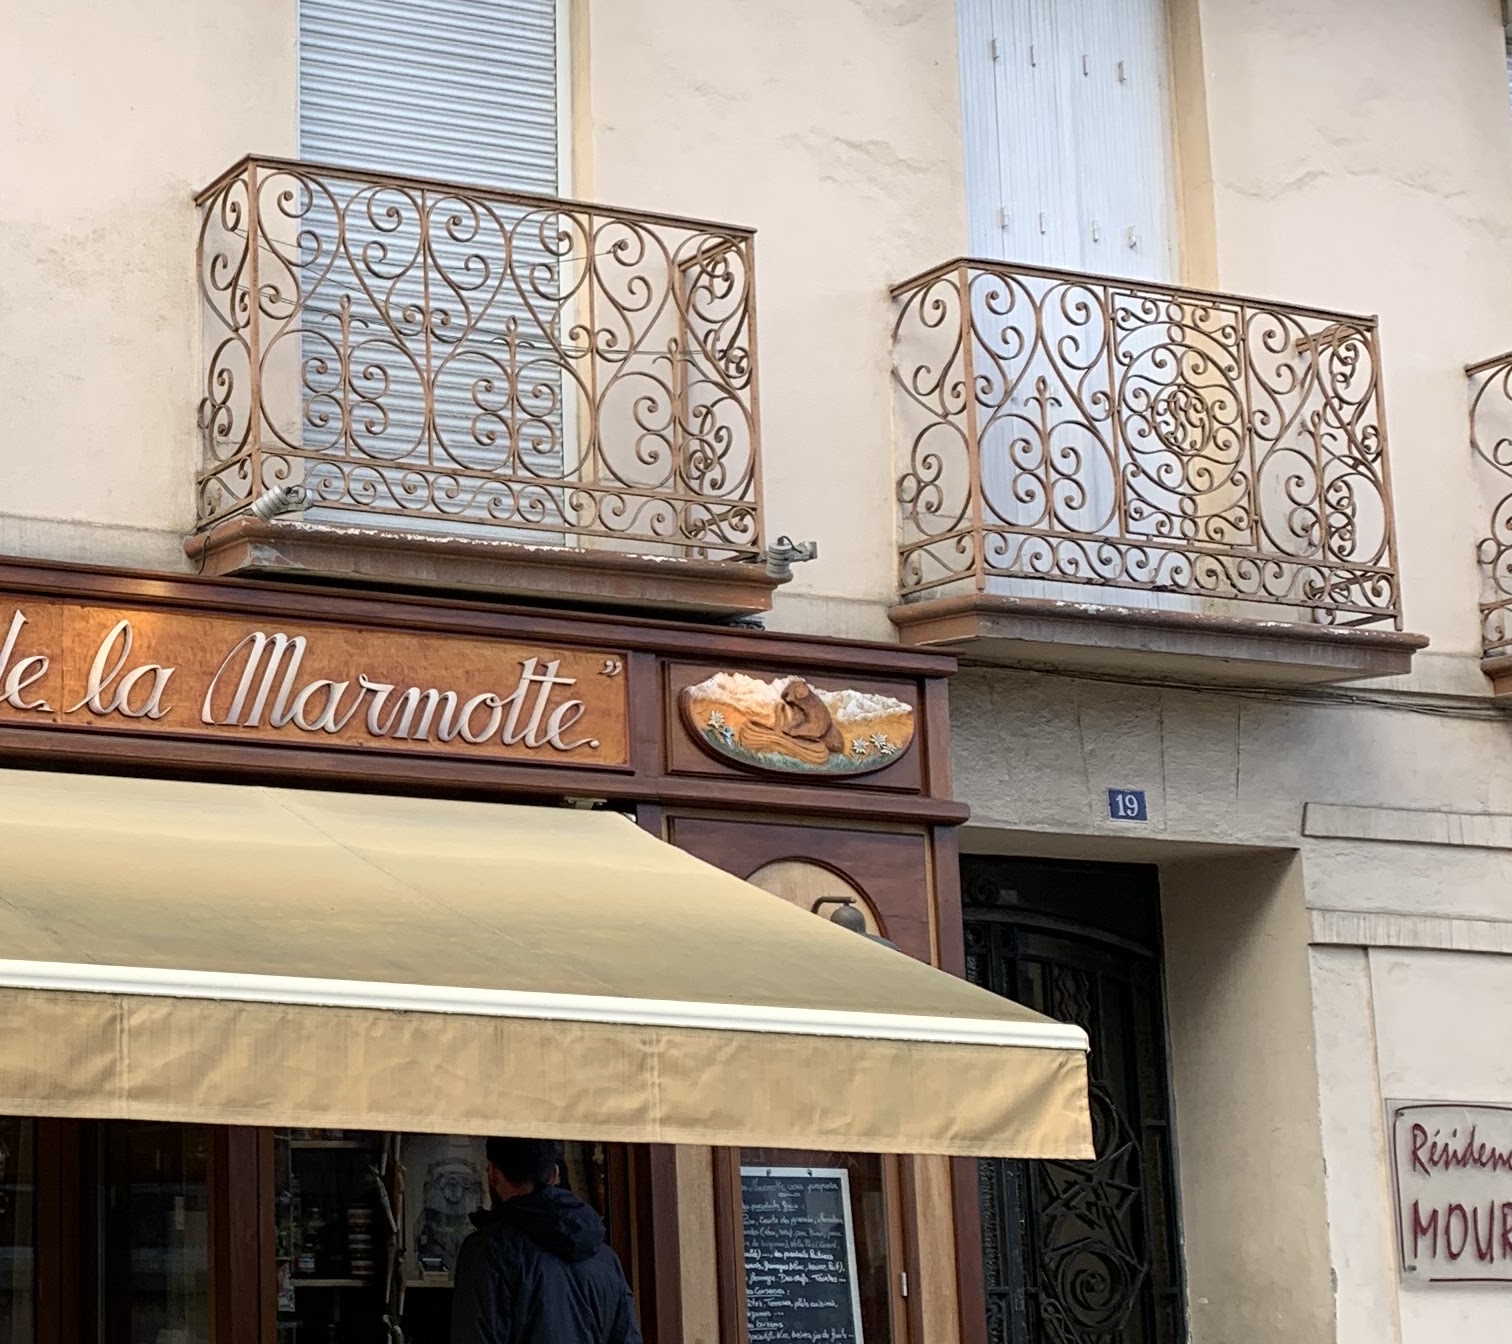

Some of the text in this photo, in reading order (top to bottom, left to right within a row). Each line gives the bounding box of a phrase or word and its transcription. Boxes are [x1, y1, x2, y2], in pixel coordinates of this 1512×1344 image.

[66, 619, 176, 721] la
[1115, 794, 1139, 817] 19
[1411, 1123, 1512, 1177] Résiden
